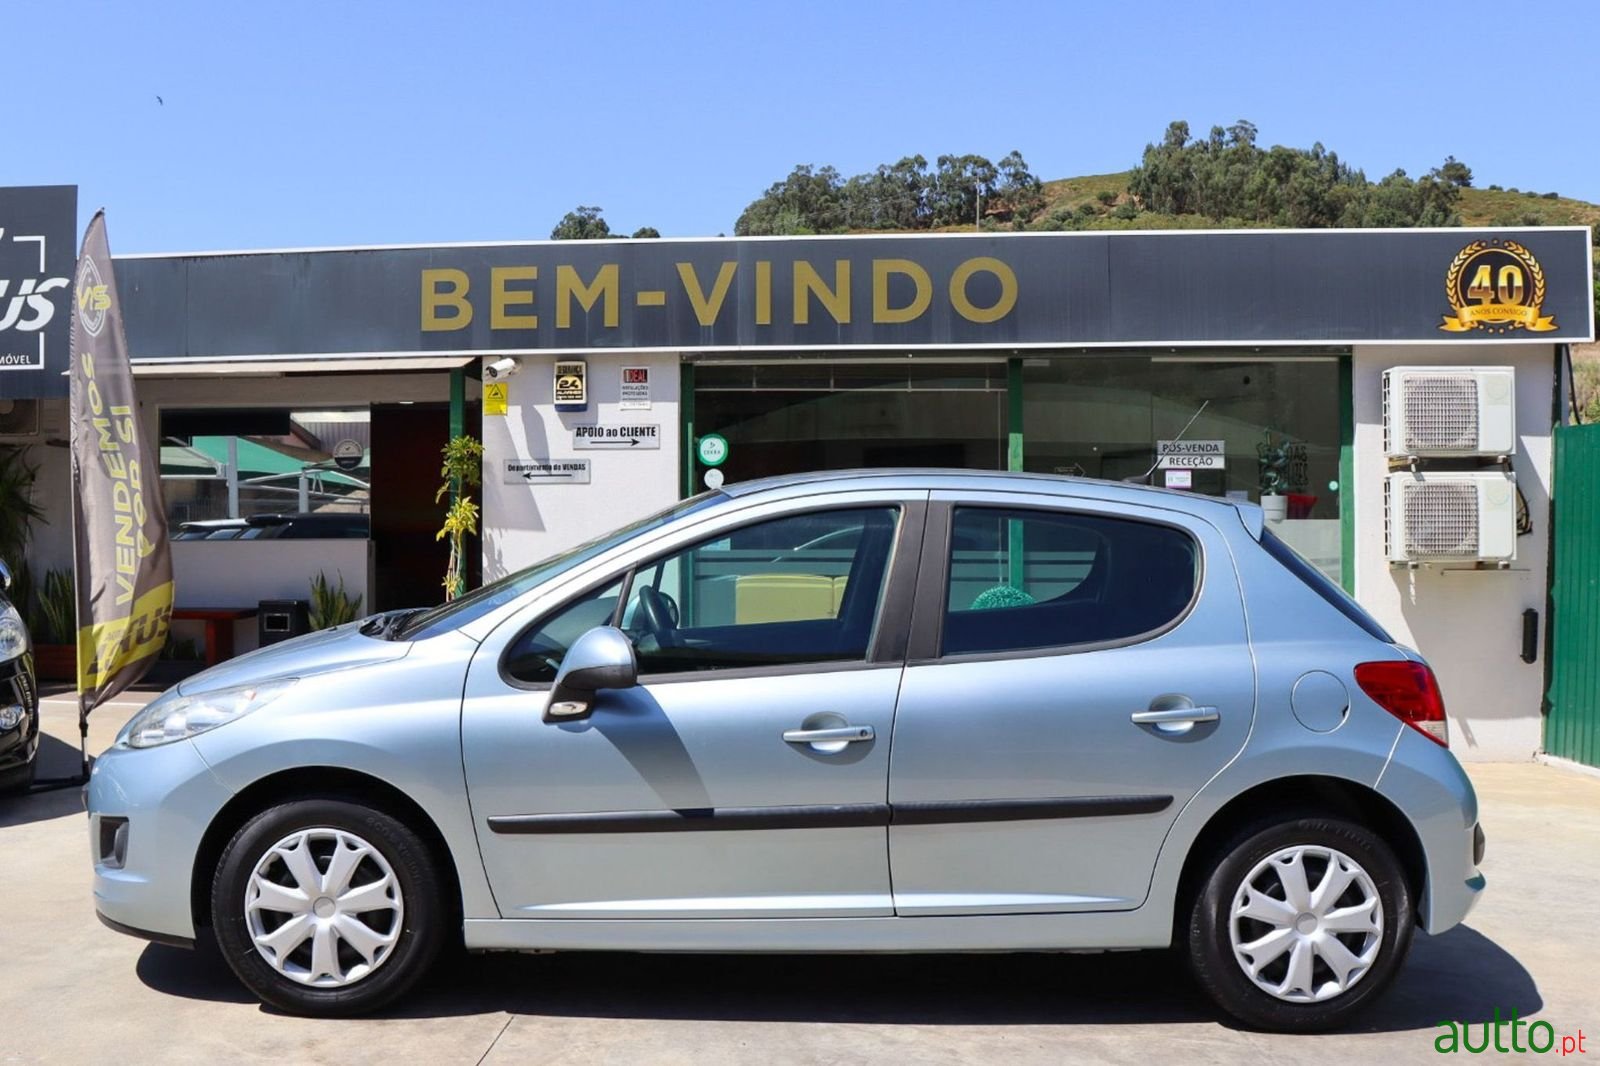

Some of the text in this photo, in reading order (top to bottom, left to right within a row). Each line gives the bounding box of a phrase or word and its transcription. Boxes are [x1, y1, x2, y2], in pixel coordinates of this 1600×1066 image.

[1466, 264, 1525, 305] 40
[420, 256, 1019, 332] BEM-VINDO
[1470, 308, 1492, 317] ANOS
[110, 404, 137, 446] SI
[575, 426, 656, 438] APOIO ao CLIENTE
[1162, 441, 1220, 453] PÓS-VENDA
[562, 463, 586, 471] VENDAS
[1168, 454, 1214, 467] RECEÇÃO
[81, 351, 136, 606] VENDEMOS
